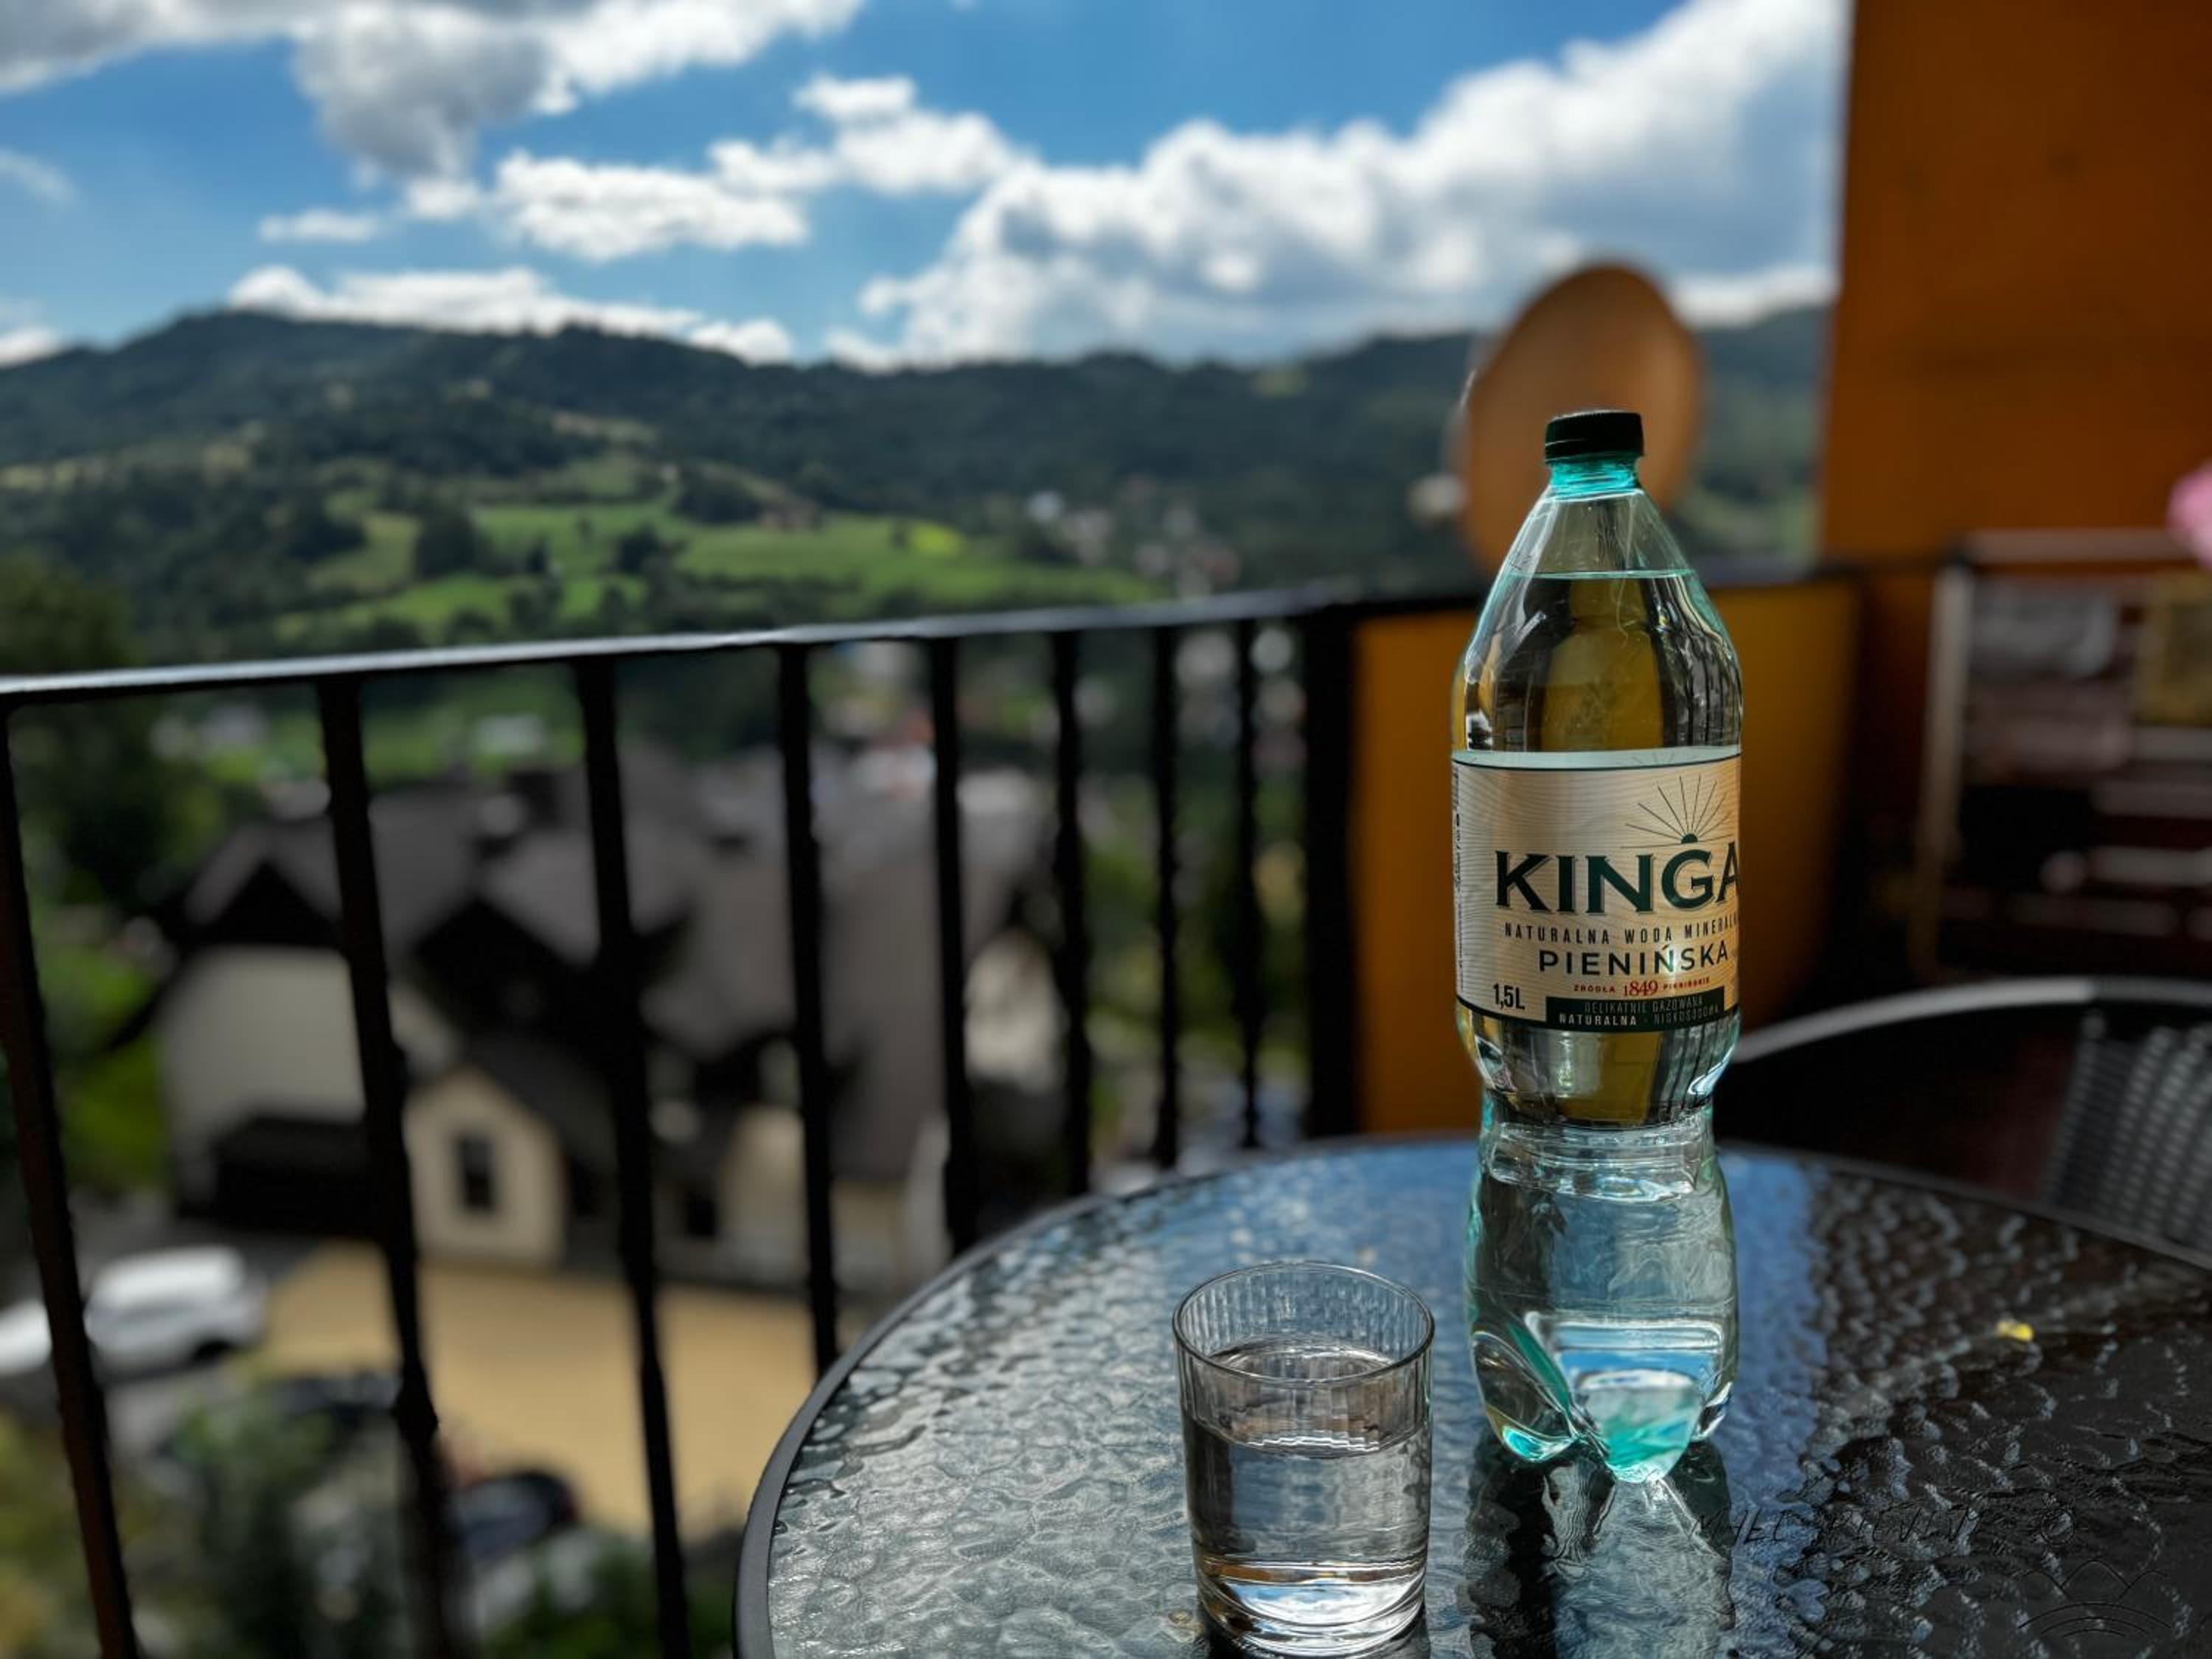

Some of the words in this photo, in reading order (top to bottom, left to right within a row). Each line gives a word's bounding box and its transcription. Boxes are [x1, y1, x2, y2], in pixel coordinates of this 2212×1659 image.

[1495, 841, 1741, 914] KINGA
[1505, 922, 1610, 945] NATURALNA
[1624, 926, 1672, 945] WODA
[1539, 939, 1728, 976] PIENIŃSKA
[1493, 983, 1526, 1009] 1,5L
[1624, 979, 1659, 997] 1849
[1559, 1013, 1637, 1026] NATURALNA
